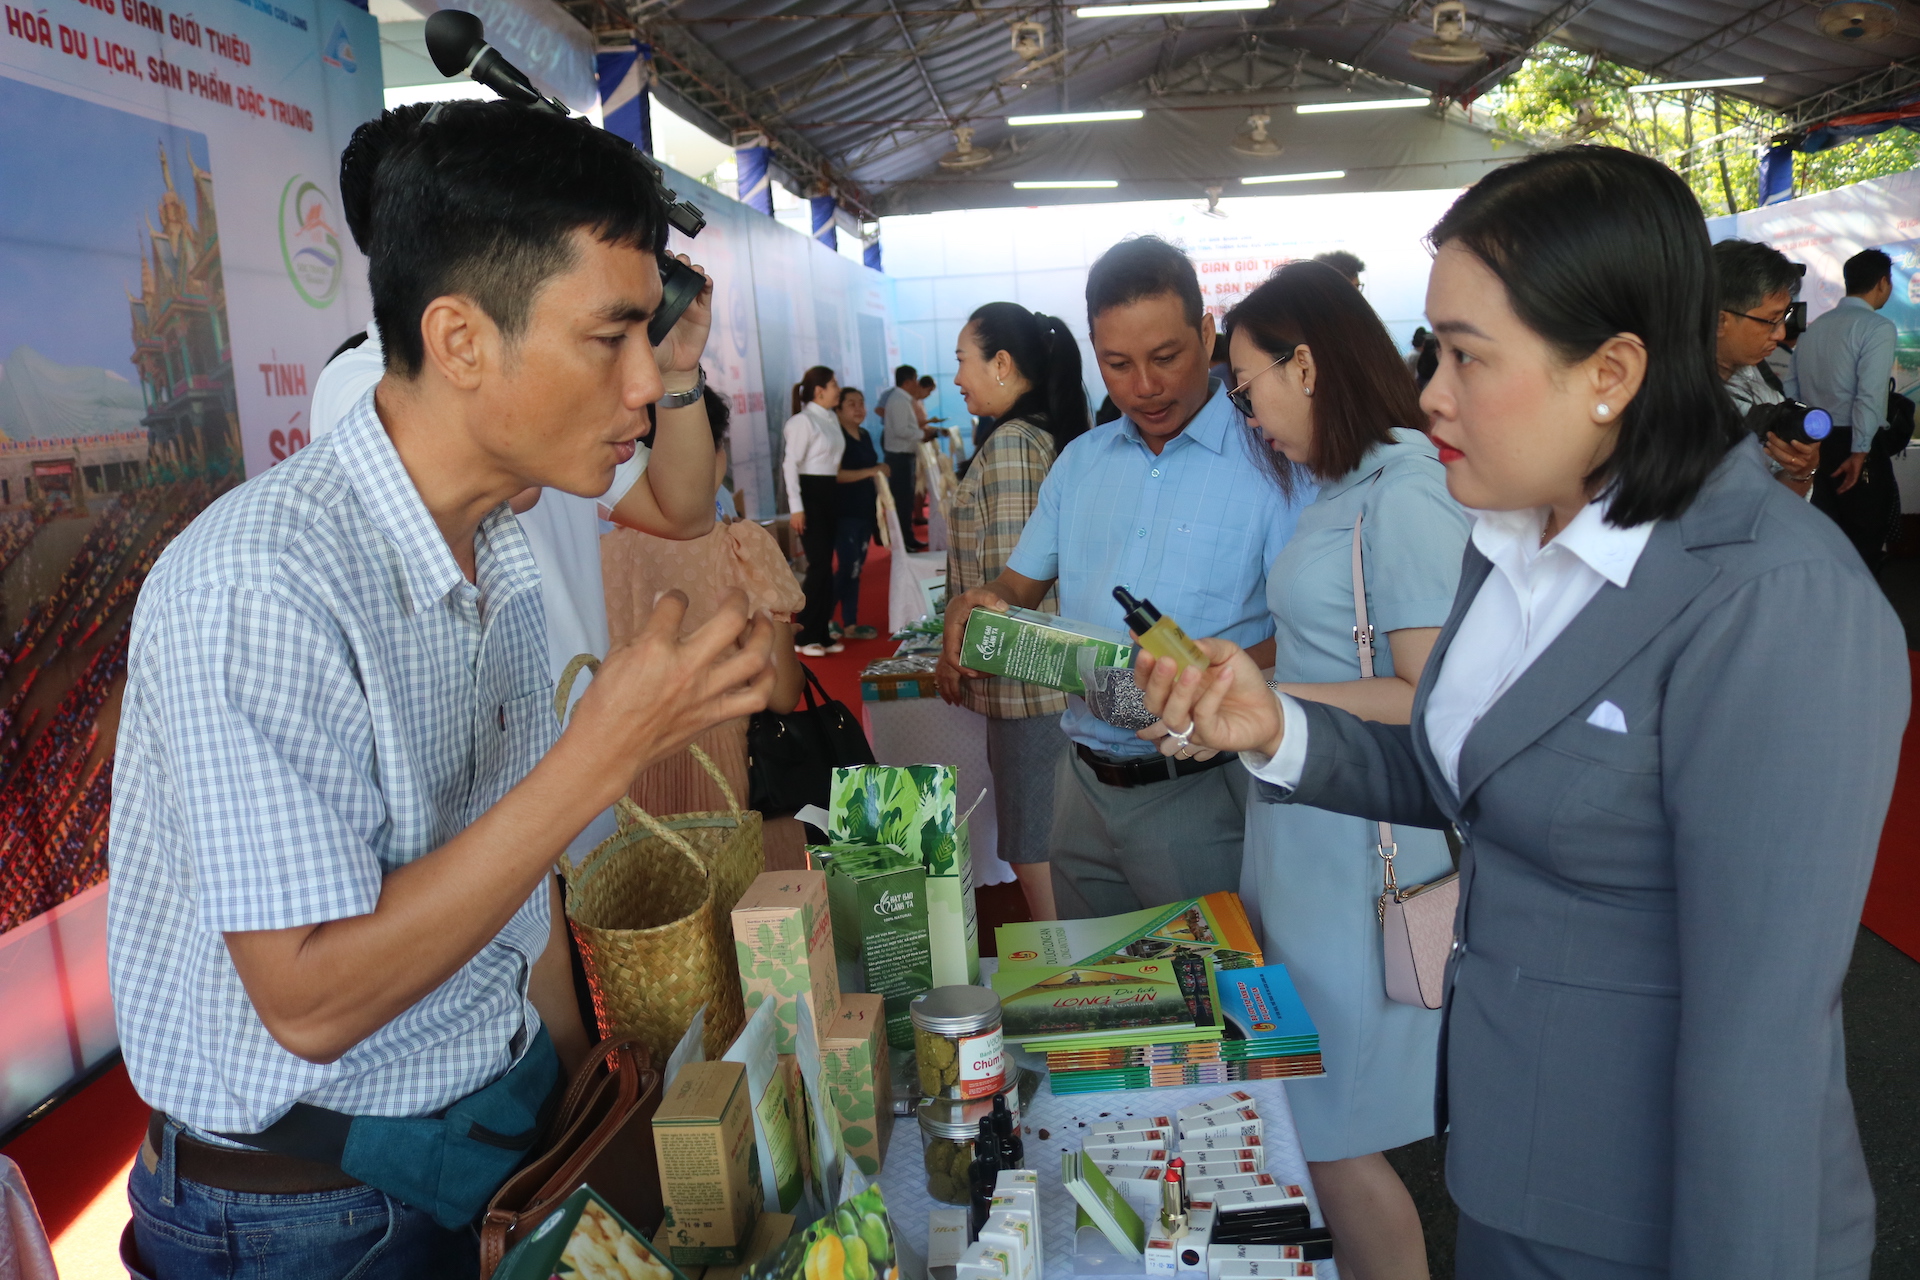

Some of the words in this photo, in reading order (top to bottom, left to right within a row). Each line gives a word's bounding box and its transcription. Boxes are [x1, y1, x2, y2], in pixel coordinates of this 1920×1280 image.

[169, 13, 202, 47] GIỚI
[205, 27, 251, 67] THIỆU
[5, 4, 53, 49] HOÁ
[58, 23, 88, 59] DU
[93, 36, 143, 80] LỊCH,
[187, 67, 233, 107] PHẨM
[236, 85, 266, 119] ĐẶC
[1201, 261, 1230, 274] GIAN
[1235, 256, 1259, 272] GIỚI
[1052, 995, 1111, 1008] LONG
[1115, 991, 1158, 1004] AN
[1113, 988, 1133, 996] Du
[973, 1055, 1000, 1071] Chùm
